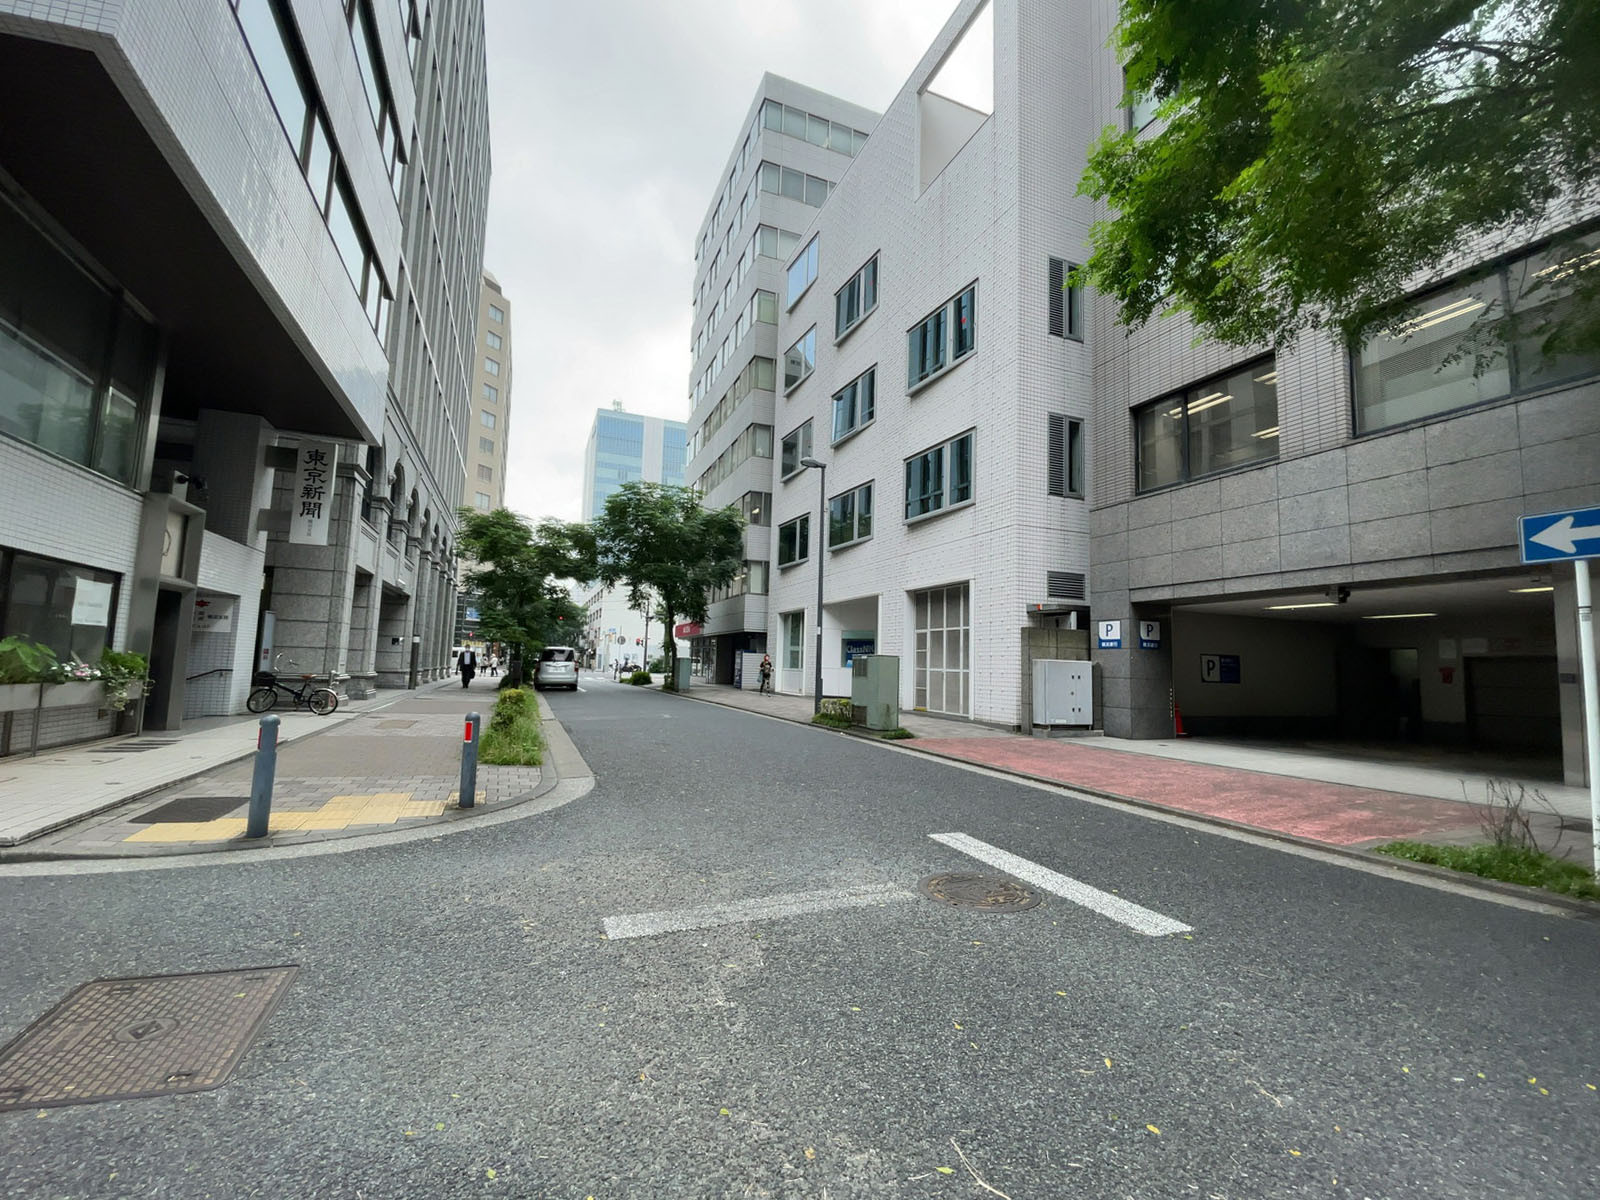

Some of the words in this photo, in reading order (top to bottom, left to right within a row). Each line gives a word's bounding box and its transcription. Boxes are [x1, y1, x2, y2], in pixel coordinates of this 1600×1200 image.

[299, 449, 328, 519] 東京新聞
[1106, 624, 1113, 637] P
[1147, 624, 1154, 637] P
[1207, 659, 1216, 677] P
